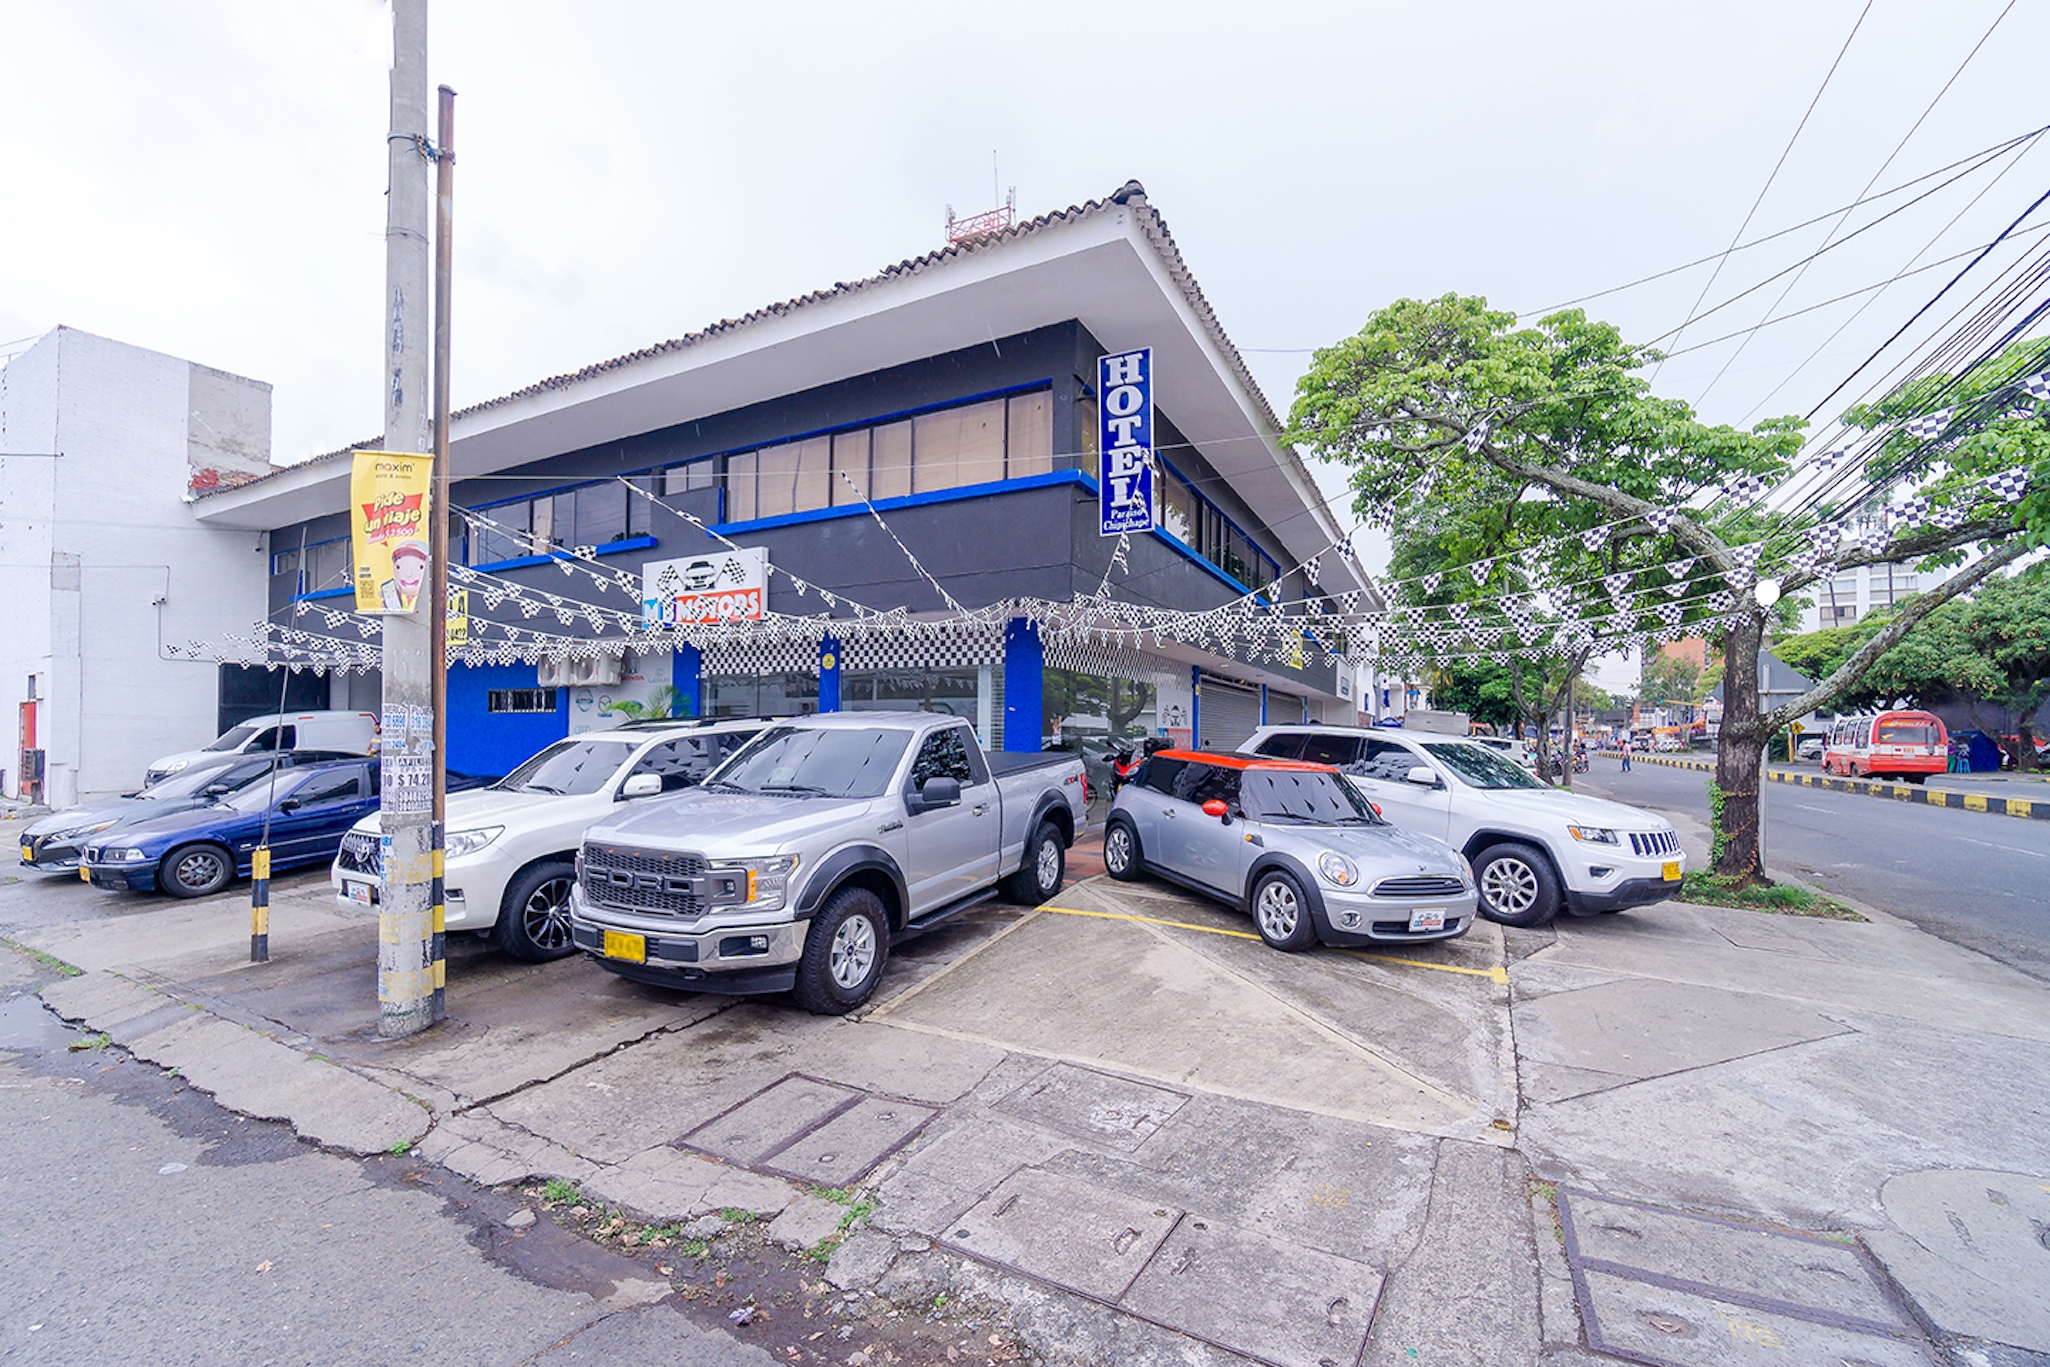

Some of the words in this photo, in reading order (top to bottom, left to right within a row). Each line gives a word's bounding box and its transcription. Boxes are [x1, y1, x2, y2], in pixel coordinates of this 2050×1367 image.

[1105, 352, 1145, 508] HOTEL
[375, 462, 412, 472] maxim
[374, 491, 406, 514] Pide
[364, 517, 382, 534] un
[383, 507, 422, 528] viaje
[677, 592, 760, 622] MOTORS
[585, 865, 694, 895] FORD
